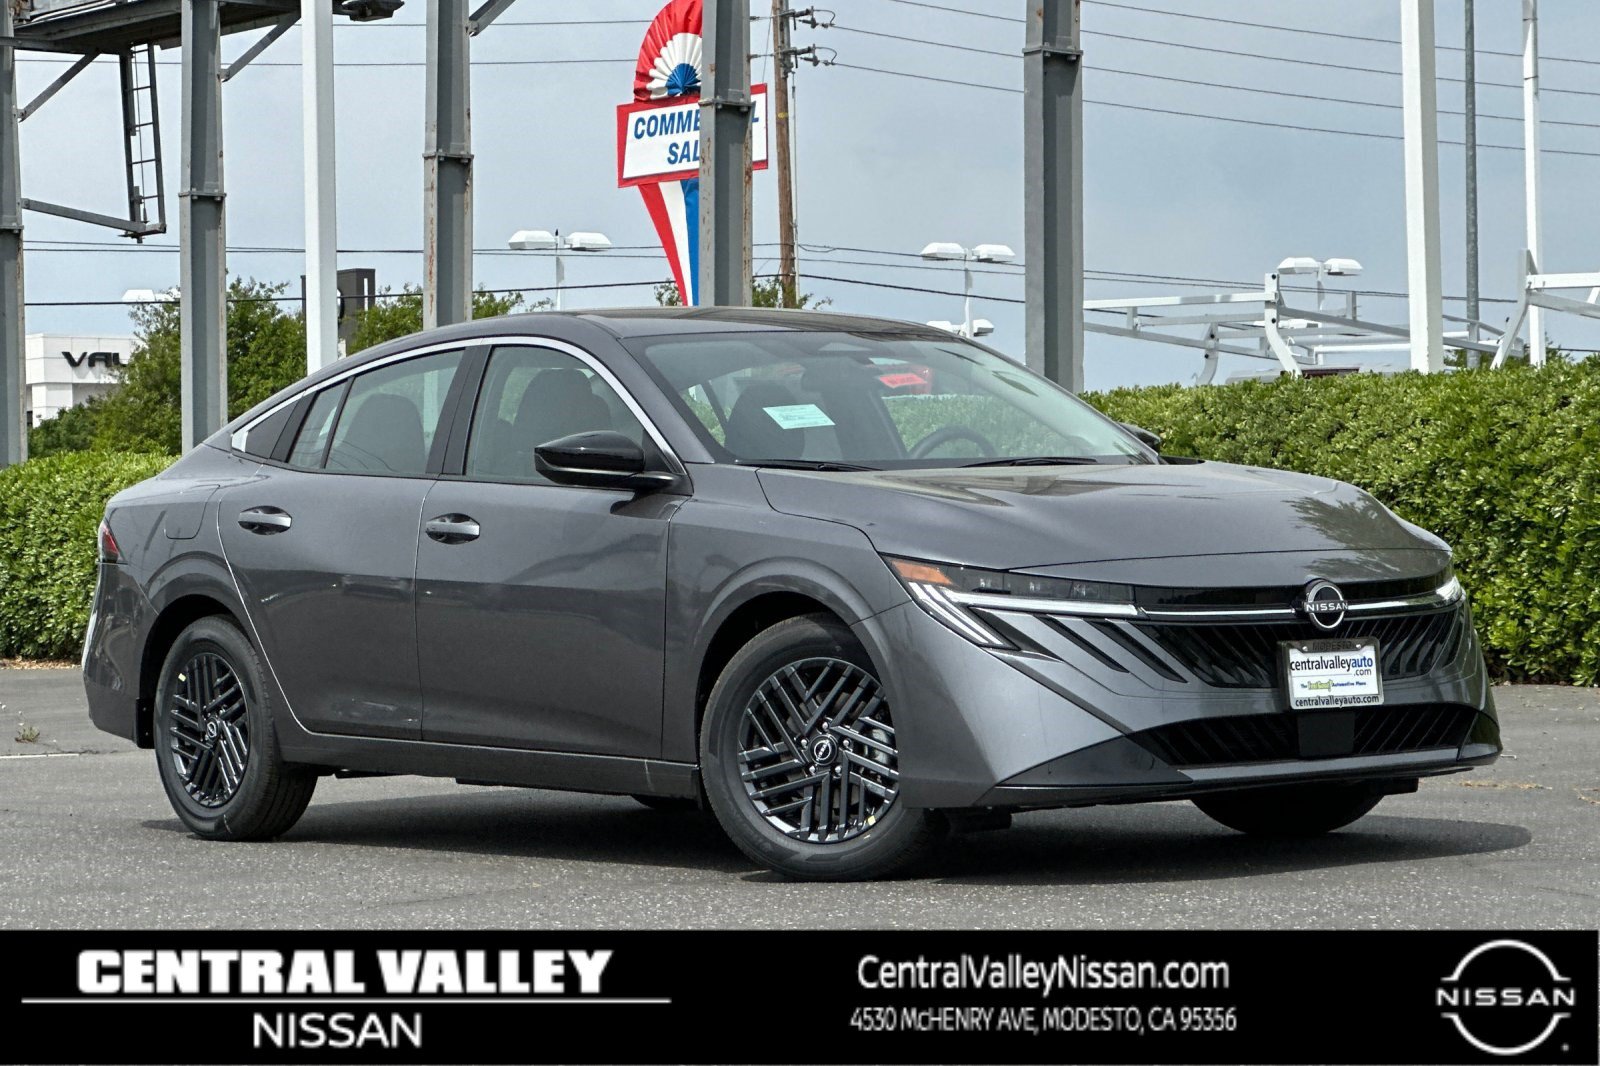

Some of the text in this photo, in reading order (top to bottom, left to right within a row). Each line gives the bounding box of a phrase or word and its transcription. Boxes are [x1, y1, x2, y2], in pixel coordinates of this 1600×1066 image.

[634, 100, 759, 139] COMMEL
[61, 352, 129, 368] VAL
[1306, 602, 1348, 612] NISSAN
[1290, 656, 1374, 671] centralvalleyauto
[1353, 669, 1372, 677] .com
[1295, 695, 1380, 707] centralvalleyauto.com
